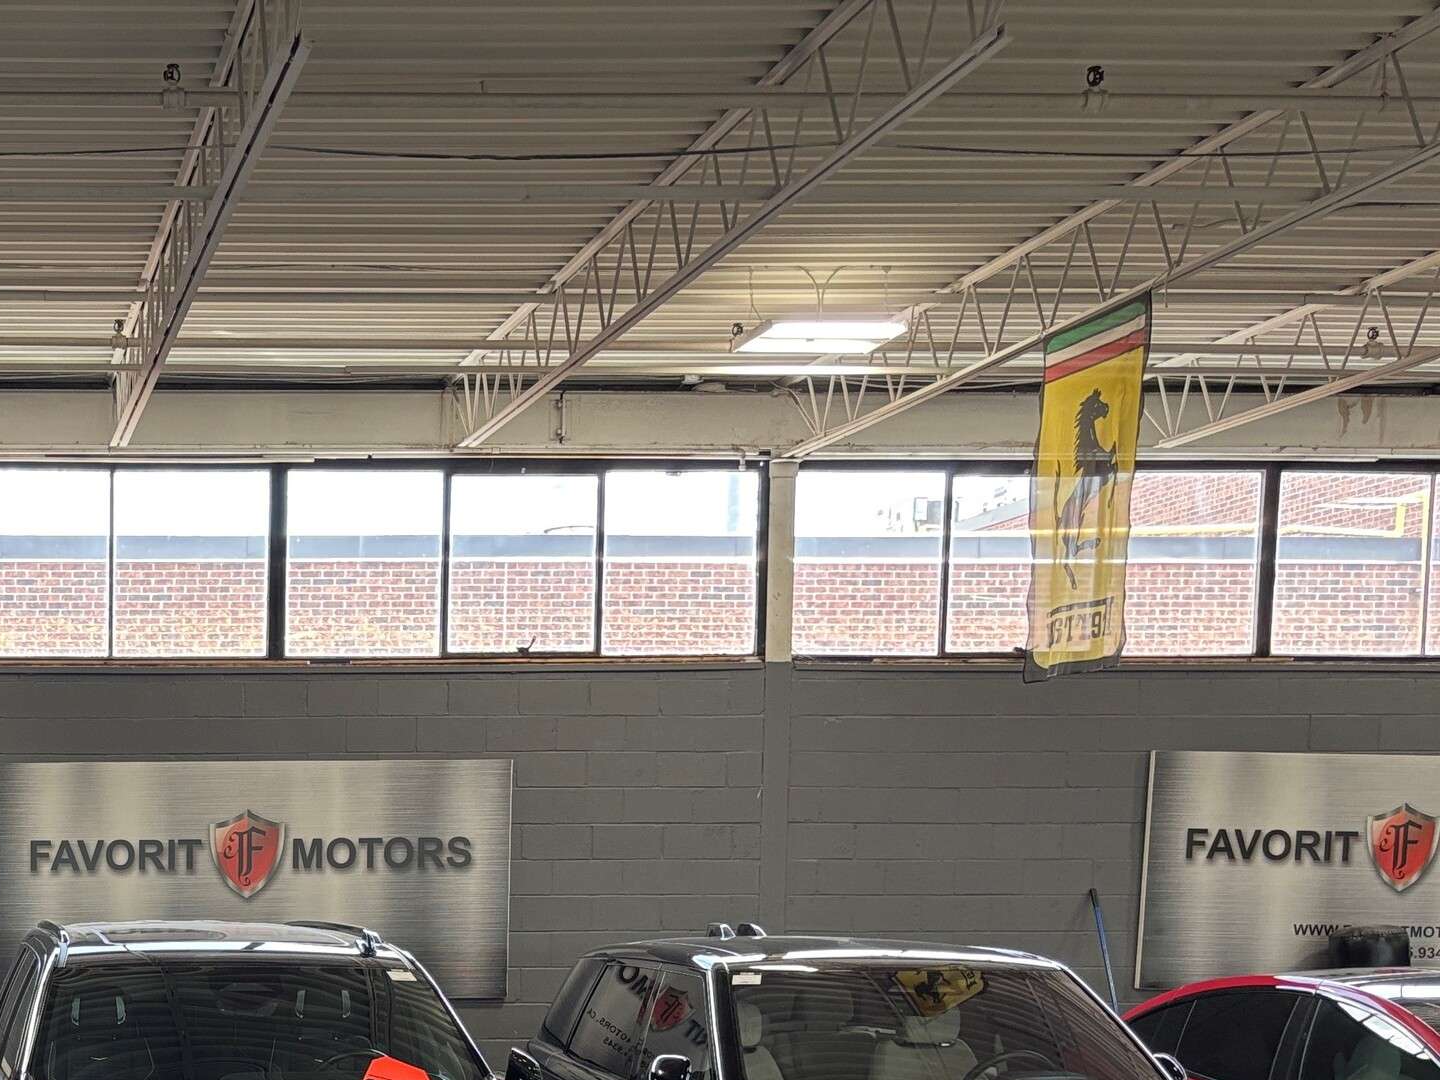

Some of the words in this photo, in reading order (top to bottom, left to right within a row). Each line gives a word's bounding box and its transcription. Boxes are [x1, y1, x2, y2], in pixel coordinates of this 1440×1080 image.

[30, 839, 202, 872] FAVORIT
[292, 836, 472, 870] MOTORS
[1185, 828, 1359, 862] FAVORIT
